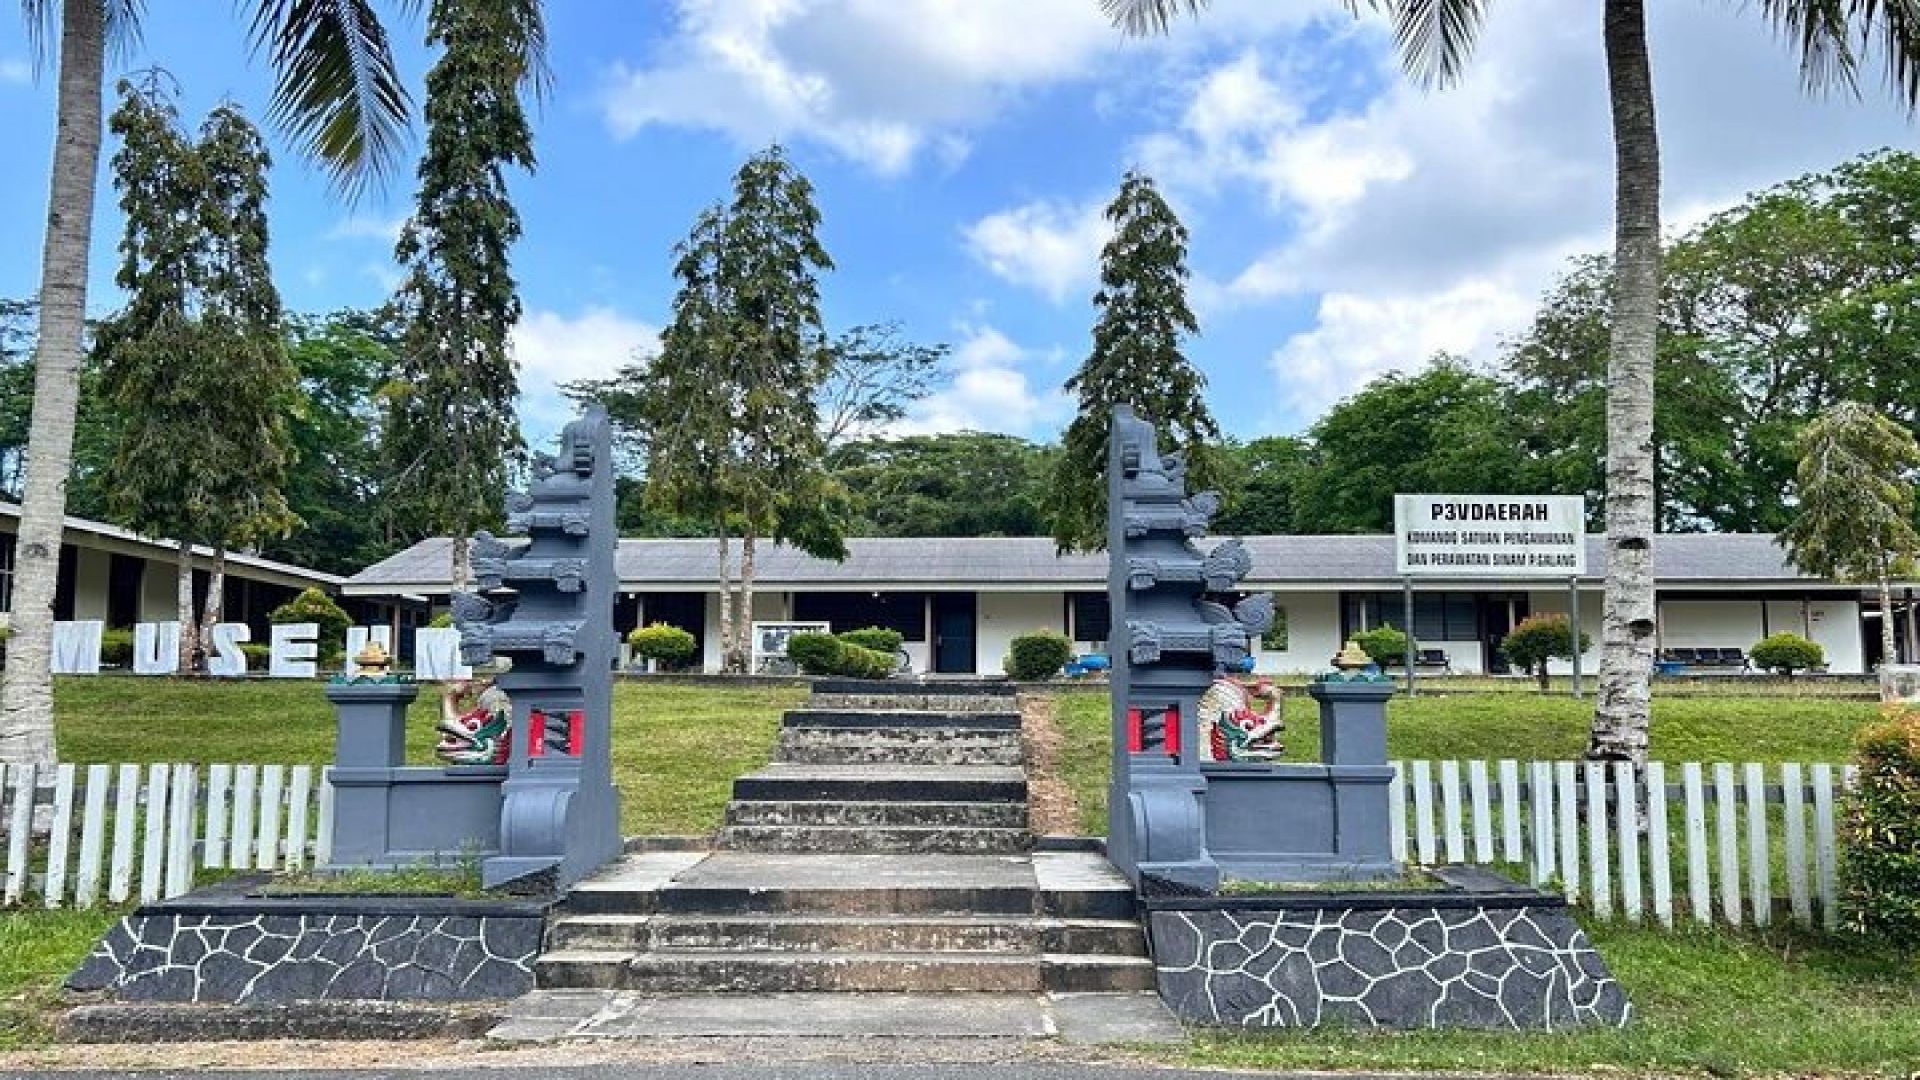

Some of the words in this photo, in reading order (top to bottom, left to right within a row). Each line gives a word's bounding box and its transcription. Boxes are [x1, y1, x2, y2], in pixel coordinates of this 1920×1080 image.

[1407, 531, 1457, 546] KOMANDO
[1461, 531, 1500, 546] SATUAN
[1407, 552, 1428, 566] DAN
[1431, 552, 1491, 566] PERAWATAN
[50, 620, 473, 680] MUSEUM
